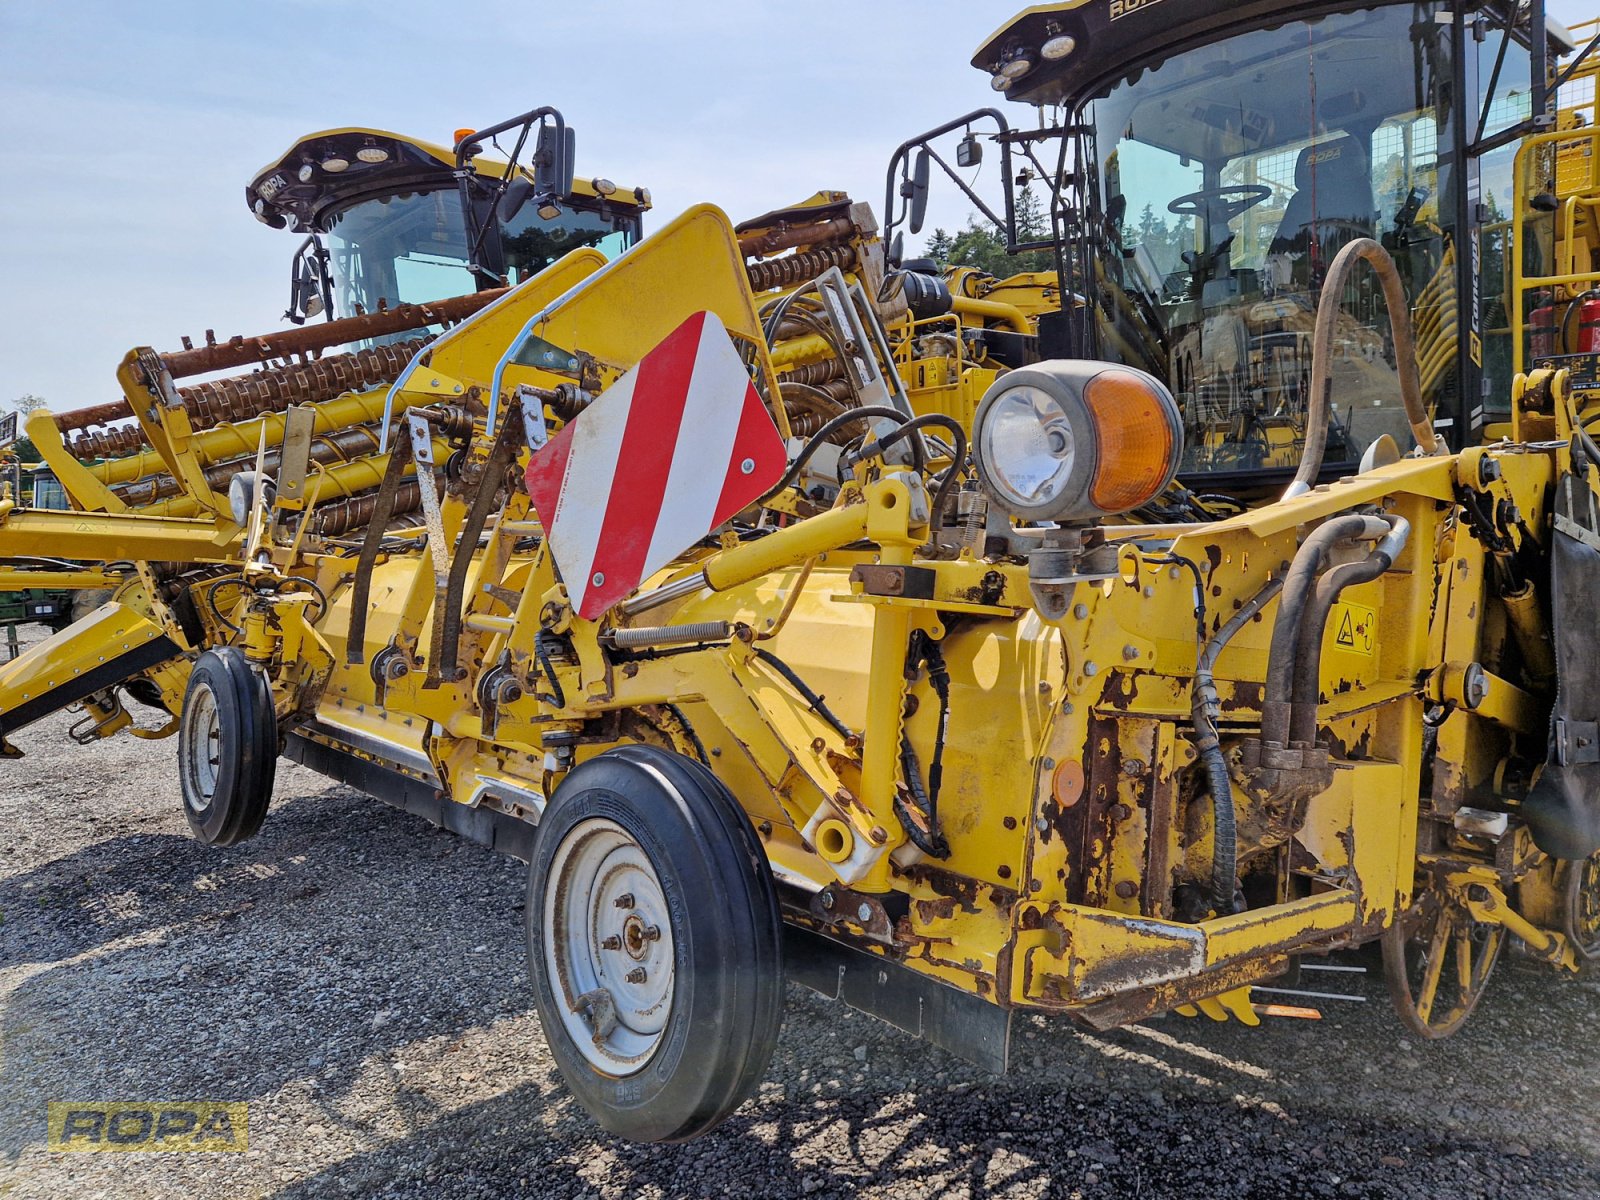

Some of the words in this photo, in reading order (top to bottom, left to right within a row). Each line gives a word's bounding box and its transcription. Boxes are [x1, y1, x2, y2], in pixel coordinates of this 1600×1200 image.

[1109, 0, 1148, 18] RO
[1305, 147, 1342, 165] ROPA
[260, 174, 287, 198] ROPA
[1471, 230, 1479, 333] Concept
